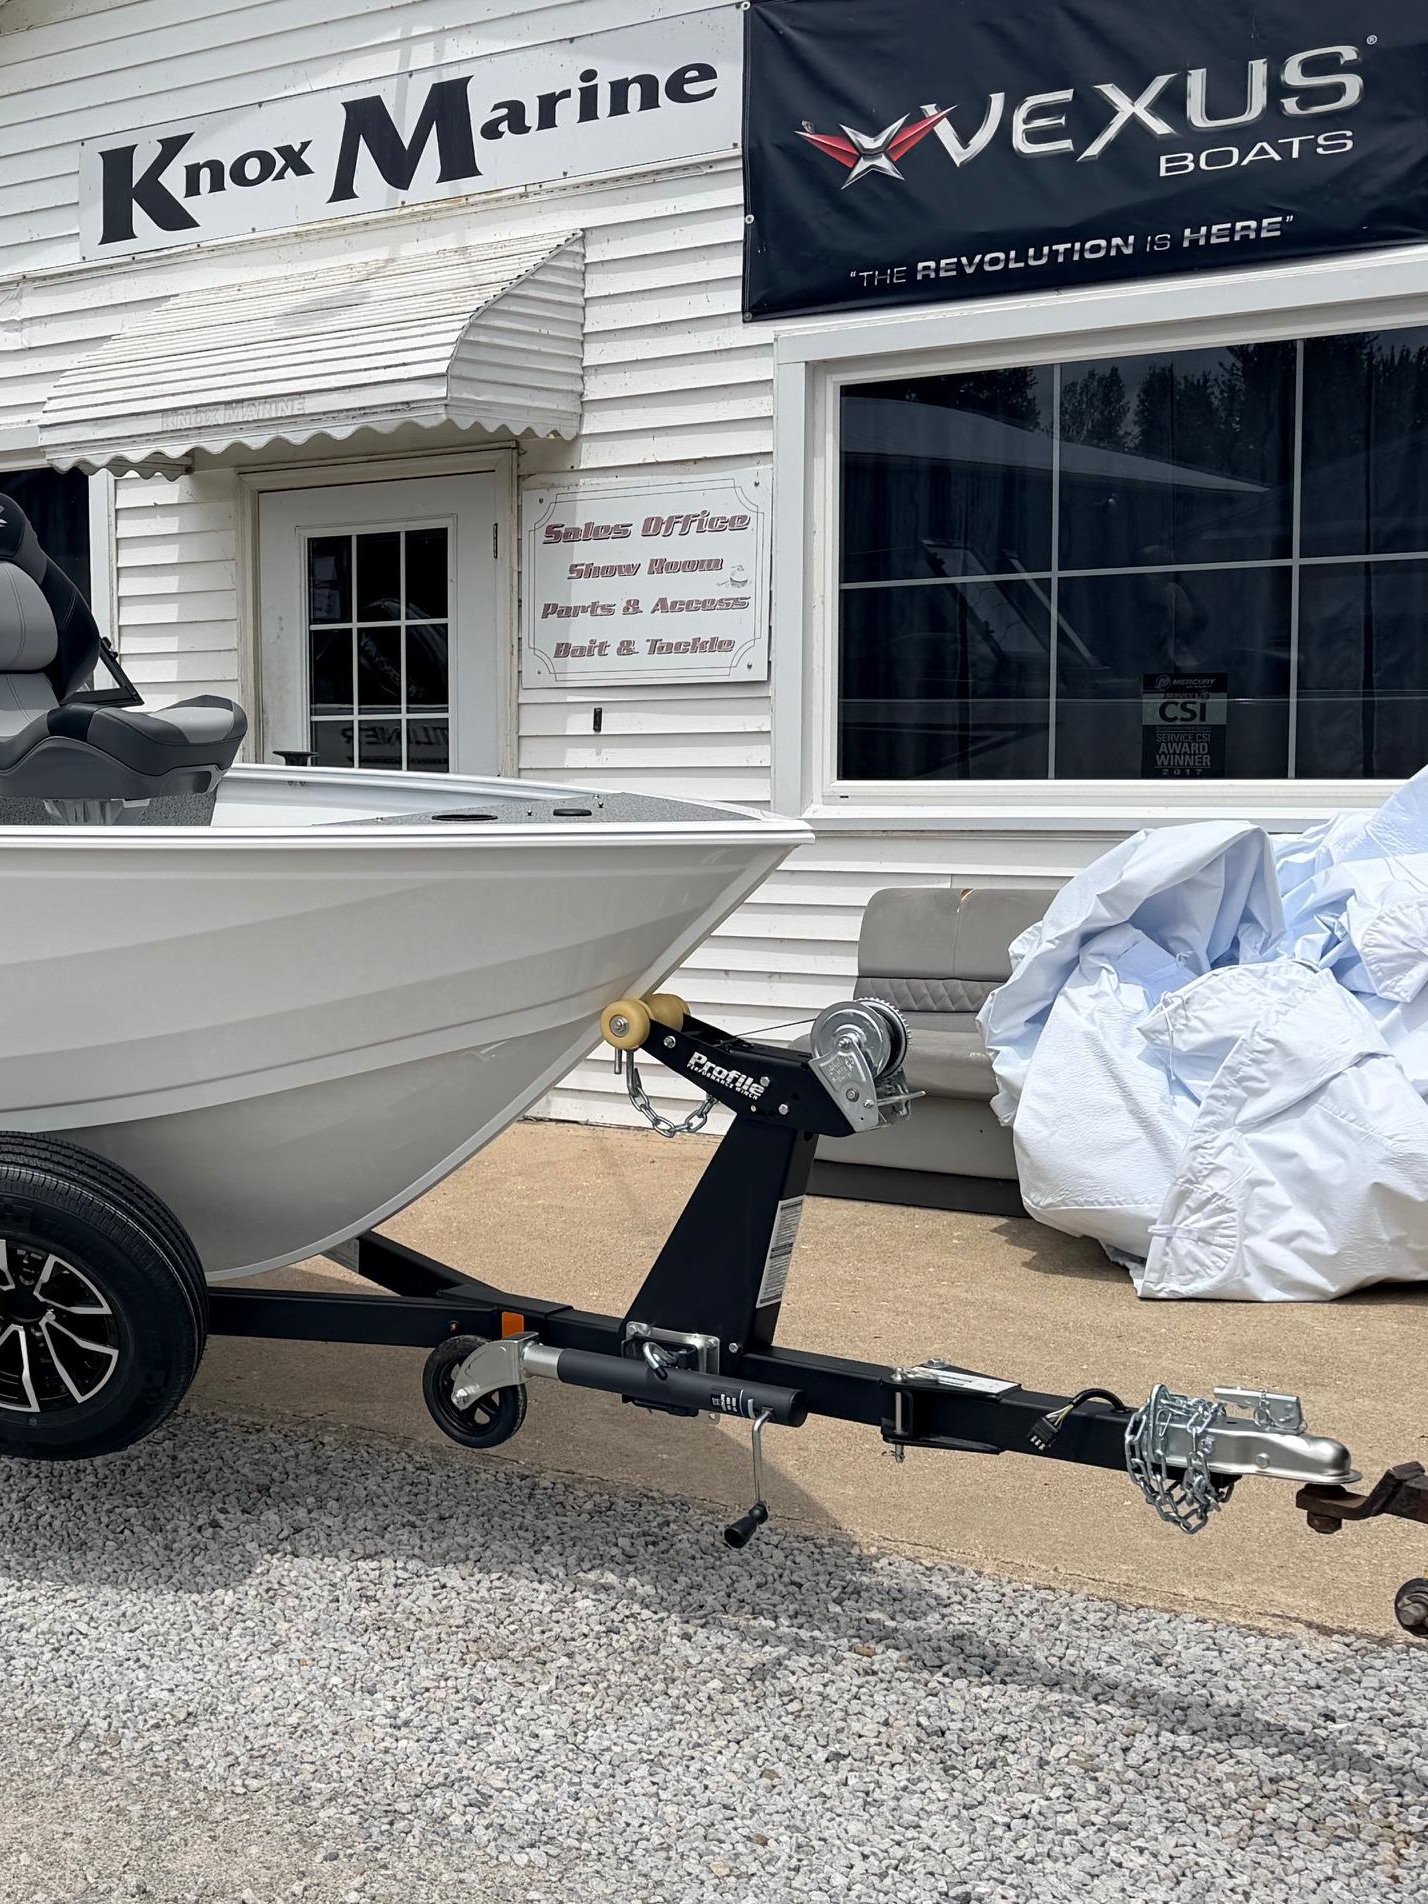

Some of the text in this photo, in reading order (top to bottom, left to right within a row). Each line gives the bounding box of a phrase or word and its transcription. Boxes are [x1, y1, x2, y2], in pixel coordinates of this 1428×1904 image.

[919, 45, 1365, 168] VEXUS
[1159, 130, 1354, 178] BOATS
[916, 235, 1135, 281] REVOLUTION
[1146, 233, 1171, 254] IS
[542, 509, 752, 545] Sales Office
[567, 557, 723, 580] Show Room
[541, 596, 751, 619] Parts & Access
[554, 636, 736, 658] Bait & Tackle
[1158, 700, 1207, 722] CSI
[1156, 733, 1211, 742] SERVICE CSI
[1158, 742, 1209, 754] AWARD
[1156, 754, 1211, 767] WINNER
[686, 1062, 734, 1089] PERFORMANCE
[688, 1051, 765, 1096] Profile
